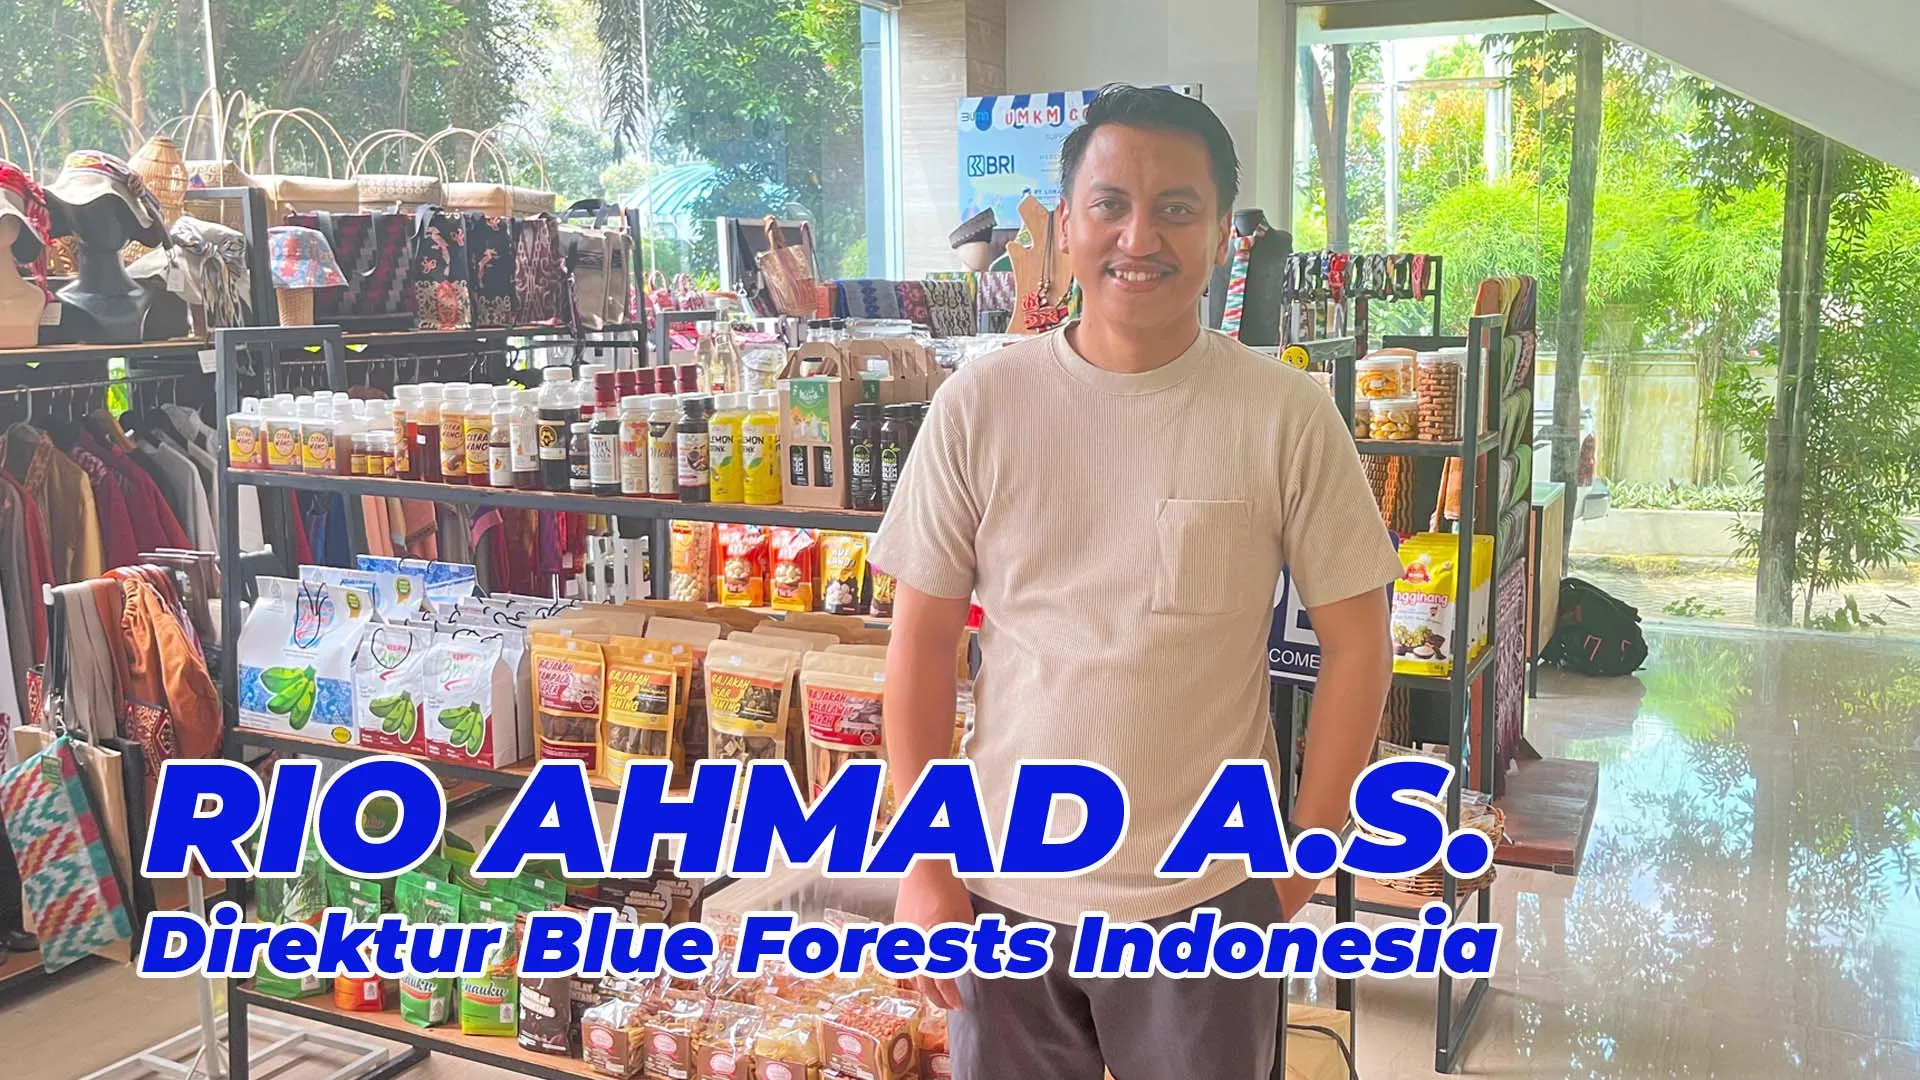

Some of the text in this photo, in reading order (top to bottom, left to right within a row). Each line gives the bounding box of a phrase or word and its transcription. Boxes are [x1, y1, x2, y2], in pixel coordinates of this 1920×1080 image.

[1005, 107, 1059, 126] UMKM
[986, 154, 1015, 174] BRI
[1393, 590, 1449, 608] ngginang
[1269, 648, 1321, 669] COME
